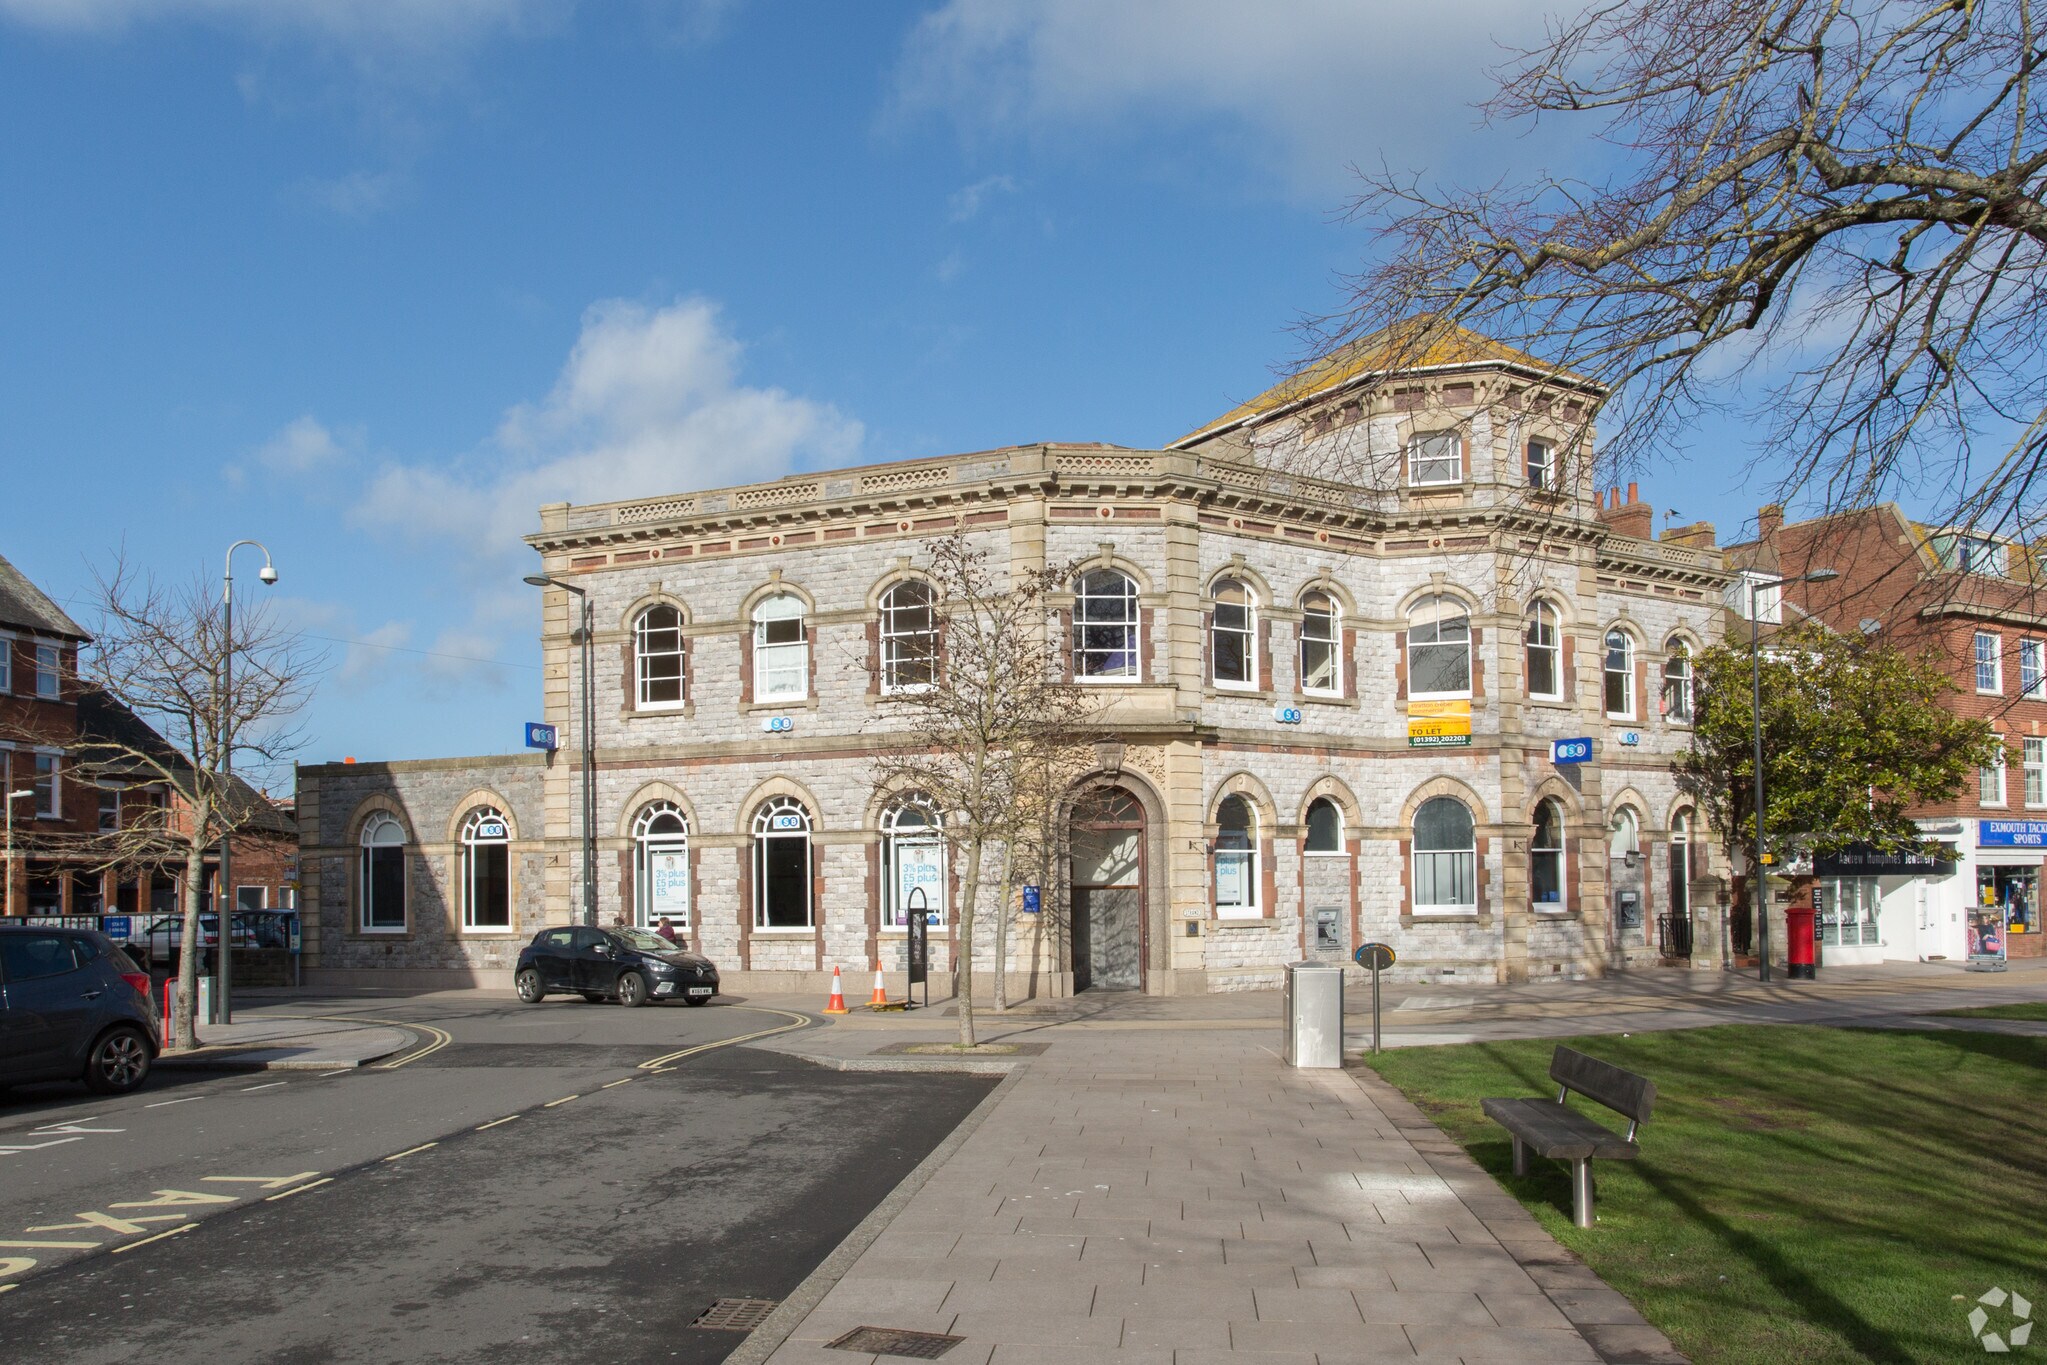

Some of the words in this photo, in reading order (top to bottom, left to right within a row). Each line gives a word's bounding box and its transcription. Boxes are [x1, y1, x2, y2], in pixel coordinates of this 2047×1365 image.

[1990, 822, 2026, 832] EXMOUTH
[2013, 834, 2041, 844] SPORTS
[903, 864, 916, 872] 3%
[917, 863, 937, 873] plus
[1220, 866, 1237, 875] plus
[656, 870, 667, 878] 3%
[668, 869, 686, 878] plus
[903, 874, 914, 882] £5
[917, 873, 937, 883] plus
[656, 879, 666, 887] £5
[668, 878, 686, 887] plus
